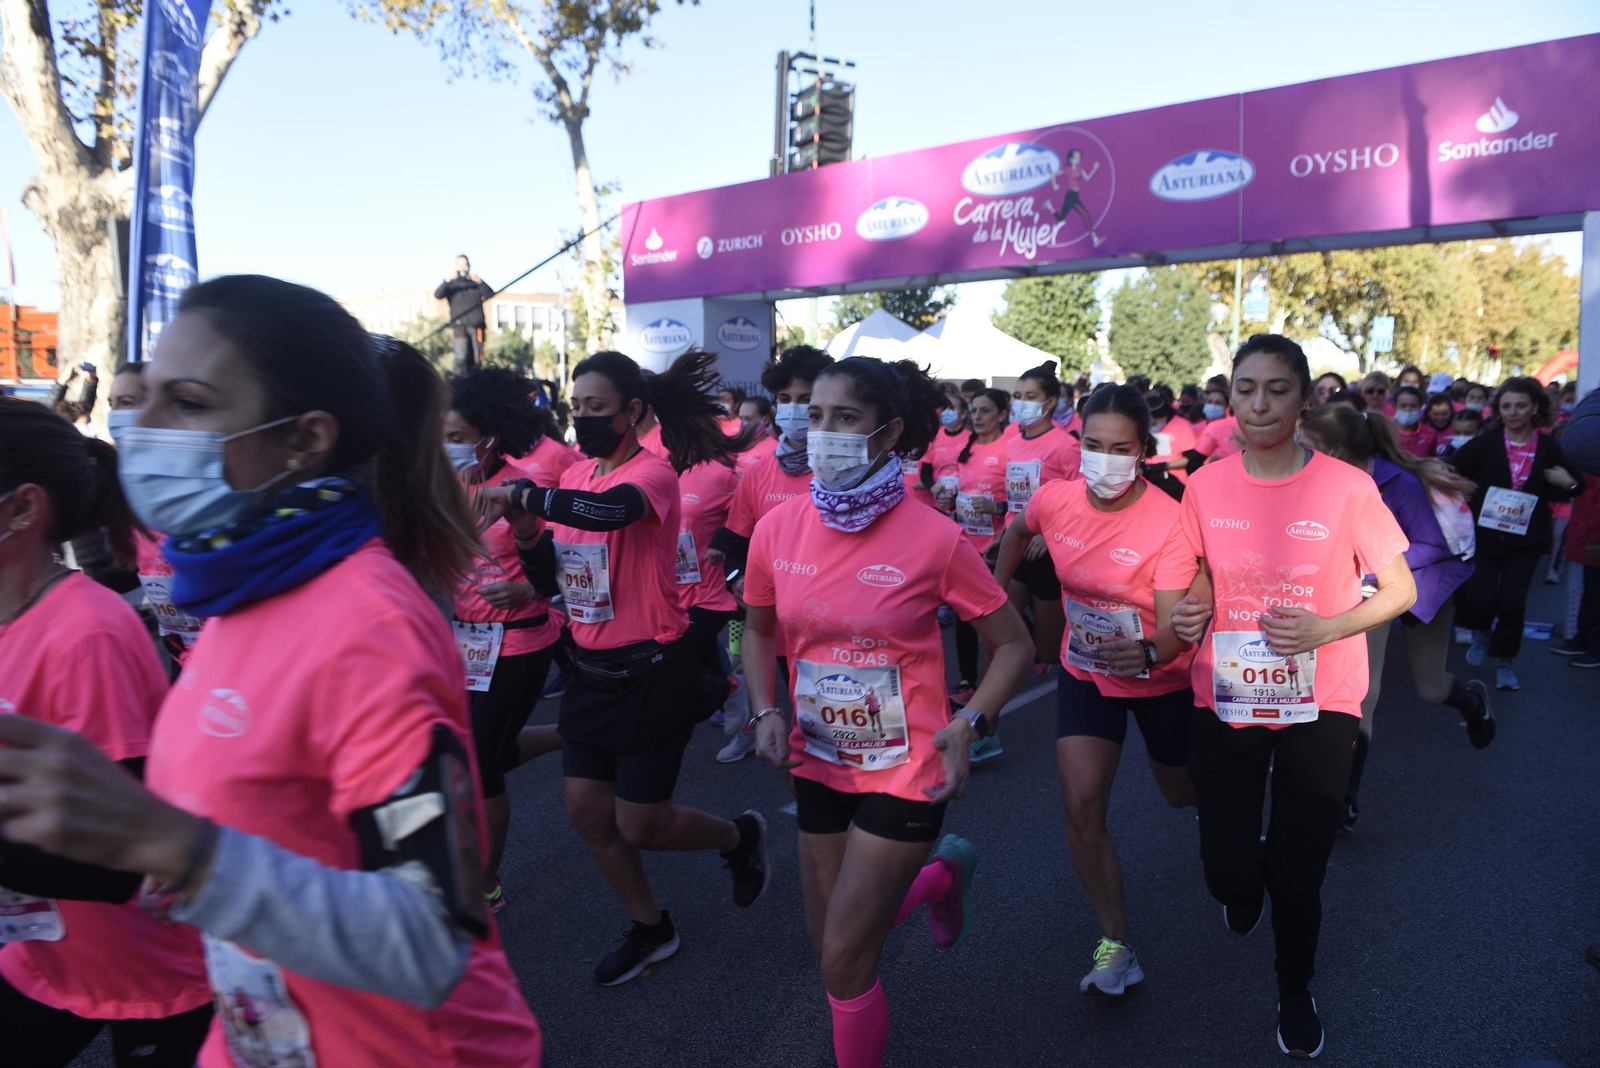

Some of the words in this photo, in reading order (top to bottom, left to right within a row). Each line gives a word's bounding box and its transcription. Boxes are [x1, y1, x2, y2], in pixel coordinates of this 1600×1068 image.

[1438, 131, 1559, 162] Santander
[1289, 142, 1400, 178] OYSHO
[970, 162, 1053, 187] ASTURIANA
[1157, 167, 1247, 194] ASTURIANA
[954, 196, 1035, 226] Carrera
[866, 215, 923, 232] ASTURIANA
[780, 221, 842, 246] OYSHO
[972, 224, 989, 243] de
[990, 221, 1003, 241] la
[999, 212, 1067, 260] Mujer
[717, 233, 764, 253] ZURICH
[631, 249, 678, 267] Santander
[1010, 482, 1026, 492] 016
[965, 510, 980, 519] 016
[1498, 504, 1520, 517] 016
[1210, 518, 1250, 531] OYSHO
[1054, 532, 1085, 550] OYSHO
[773, 558, 818, 577] OYSHO
[566, 573, 589, 589] 016
[1282, 583, 1314, 598] POR
[852, 635, 889, 649] POR
[468, 648, 486, 662] 016
[832, 646, 889, 666] TODAS
[1242, 668, 1287, 685] 016
[1232, 696, 1259, 704] CARRERA
[1253, 688, 1276, 696] 1913
[820, 706, 868, 728] 016
[1217, 708, 1249, 717] OYSHO
